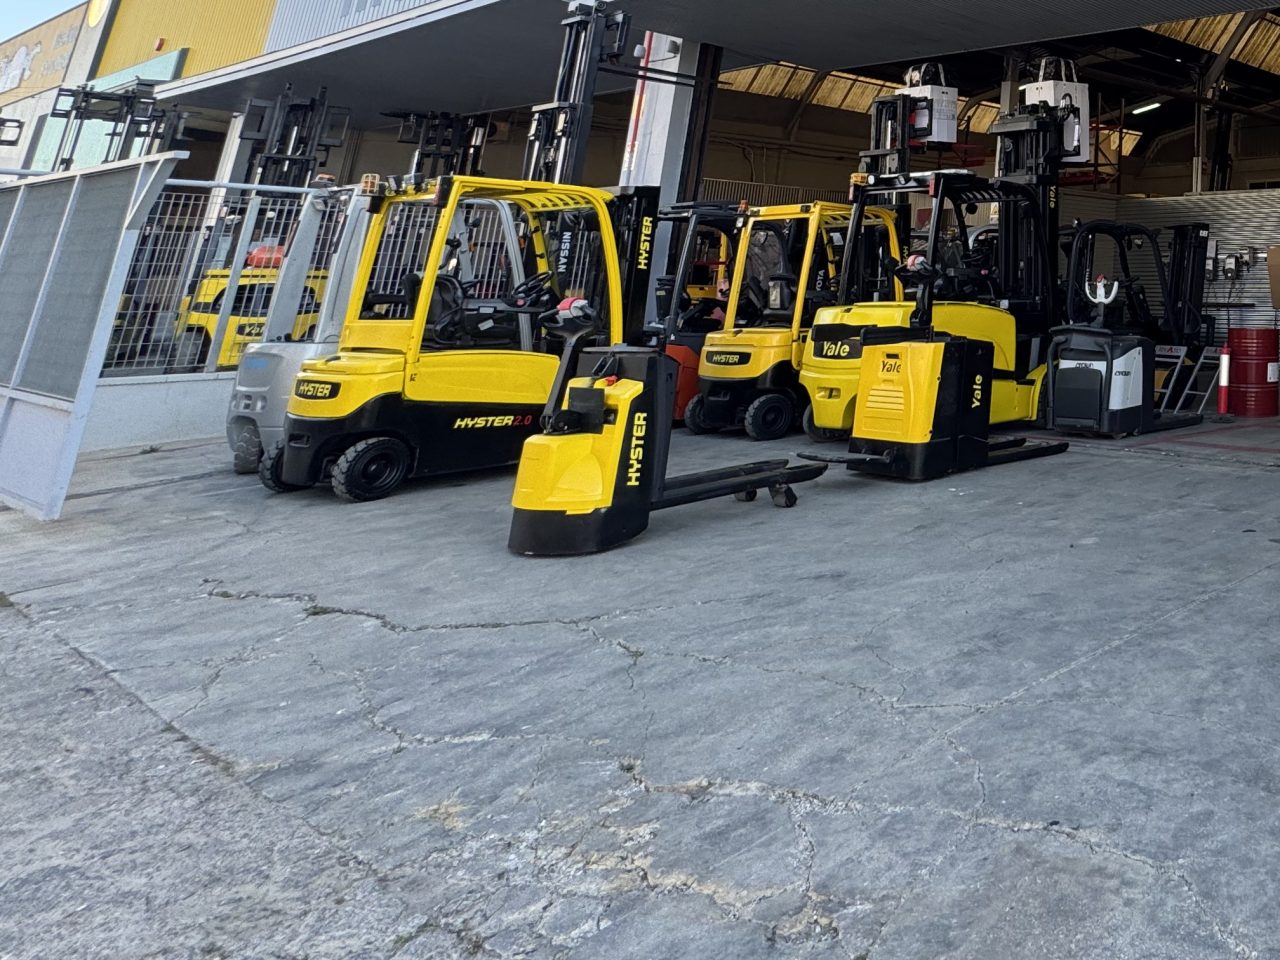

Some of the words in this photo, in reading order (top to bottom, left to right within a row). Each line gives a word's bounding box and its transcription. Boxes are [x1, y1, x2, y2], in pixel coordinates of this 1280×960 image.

[637, 216, 653, 270] HYSTER
[557, 231, 573, 272] NISSAN
[822, 341, 850, 357] Yale
[712, 354, 740, 363] HYSTER
[881, 360, 901, 373] Yale
[298, 383, 332, 397] HYSTER
[971, 374, 983, 409] Yale
[453, 416, 514, 429] HYSTER
[626, 412, 648, 486] HYSTER
